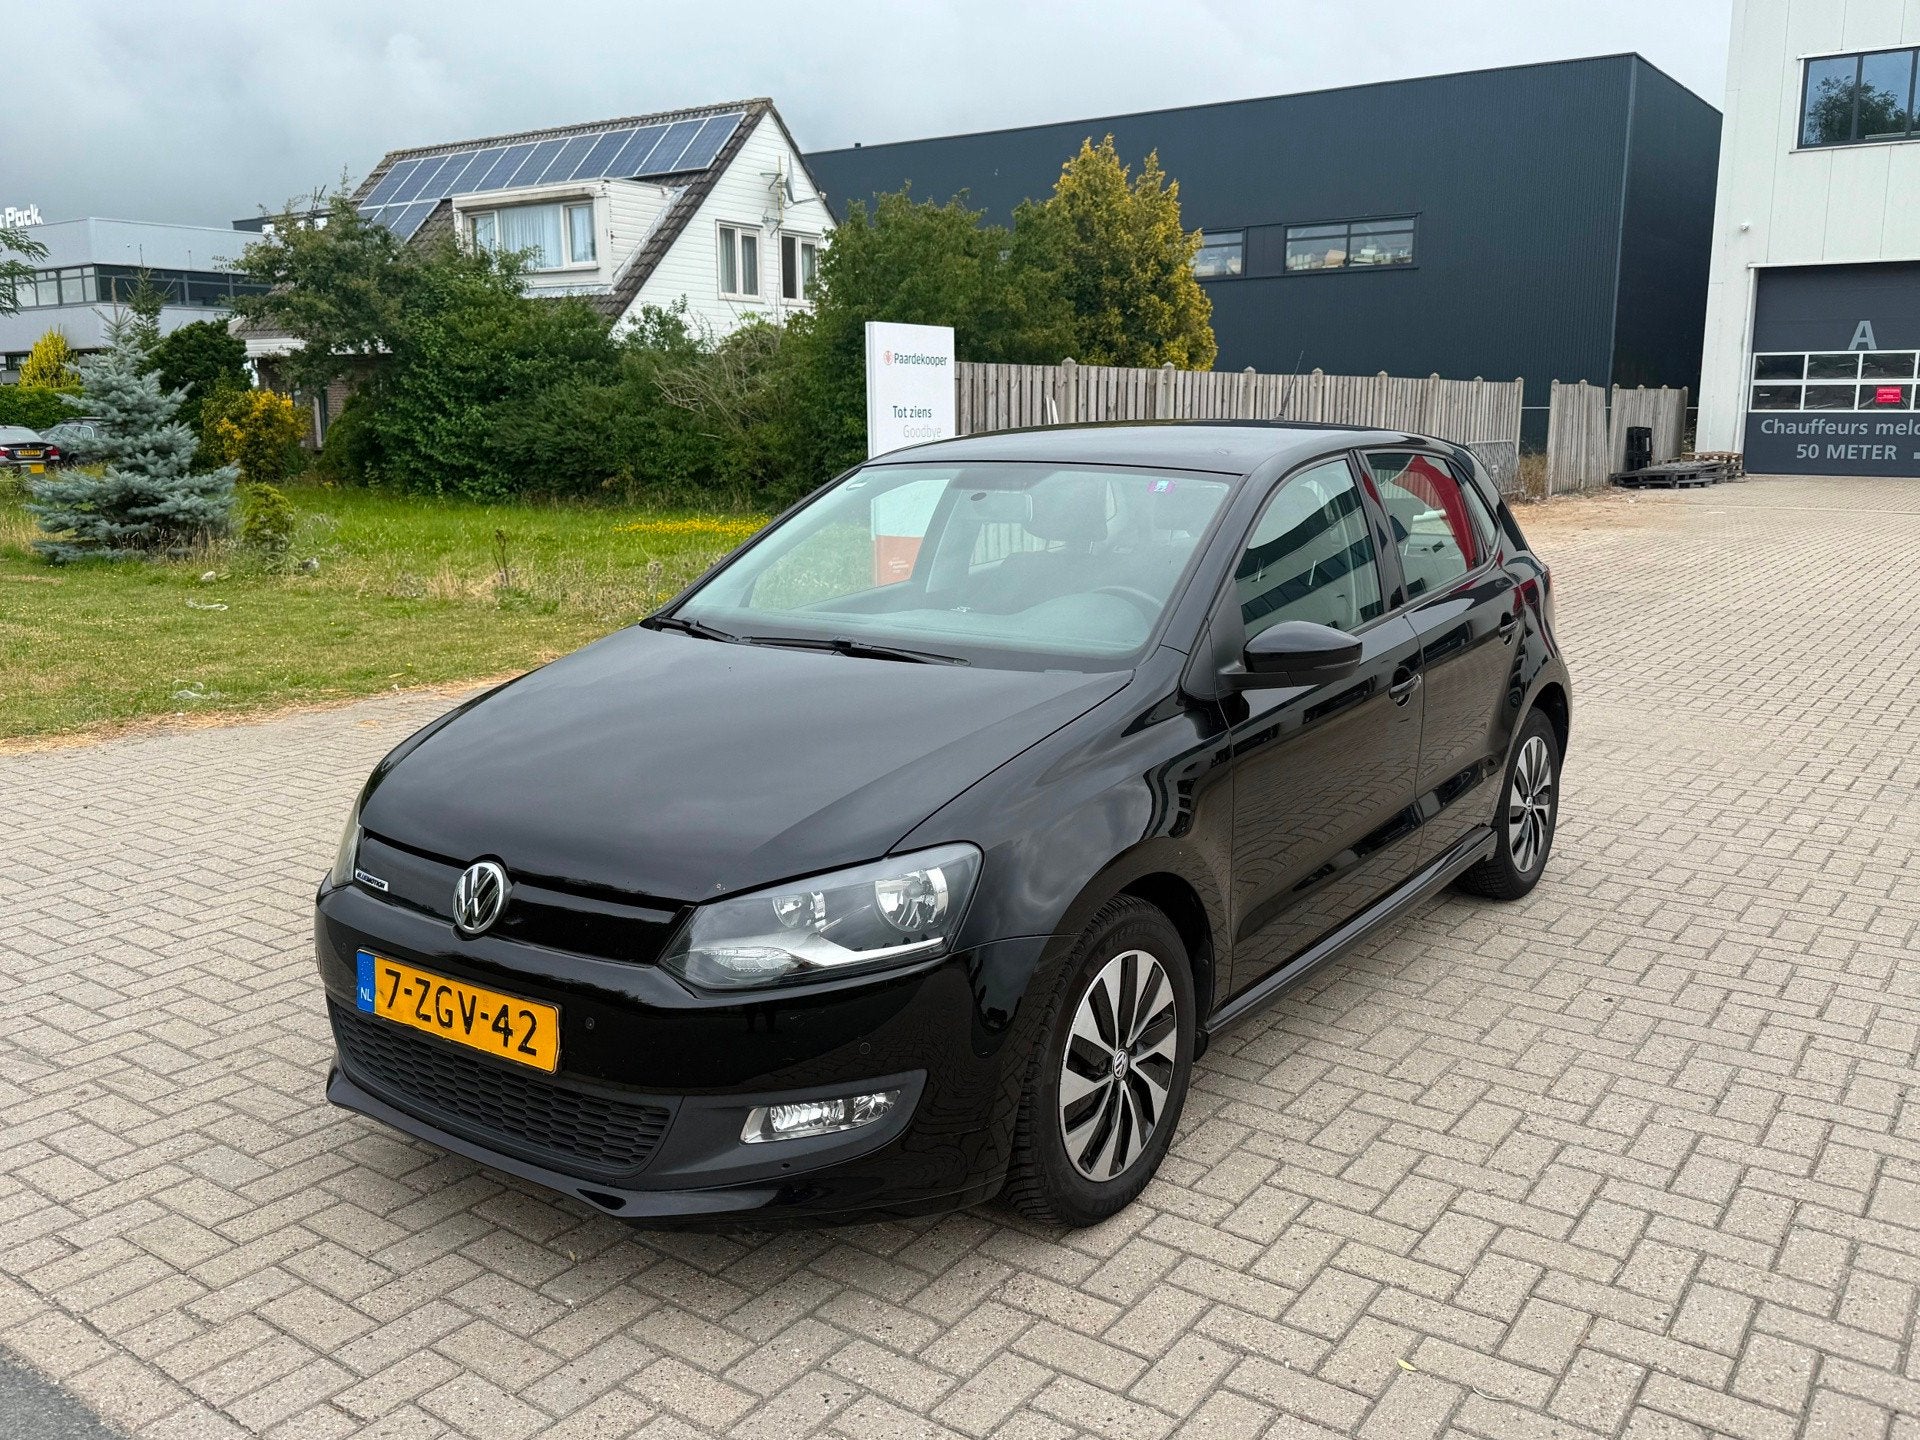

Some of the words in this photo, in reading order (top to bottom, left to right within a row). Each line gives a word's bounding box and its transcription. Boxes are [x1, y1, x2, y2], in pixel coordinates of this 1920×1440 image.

[4, 203, 44, 229] Pack
[1848, 320, 1877, 350] A
[894, 353, 947, 367] Paardekooper
[892, 405, 908, 419] Tot
[909, 405, 932, 419] ziens
[903, 424, 942, 439] Goodbye
[1760, 418, 1868, 435] Chauffeurs
[1796, 444, 1820, 459] 50
[1826, 444, 1897, 460] METER
[360, 986, 373, 1003] NL
[384, 968, 538, 1057] 7-ZGV-42
